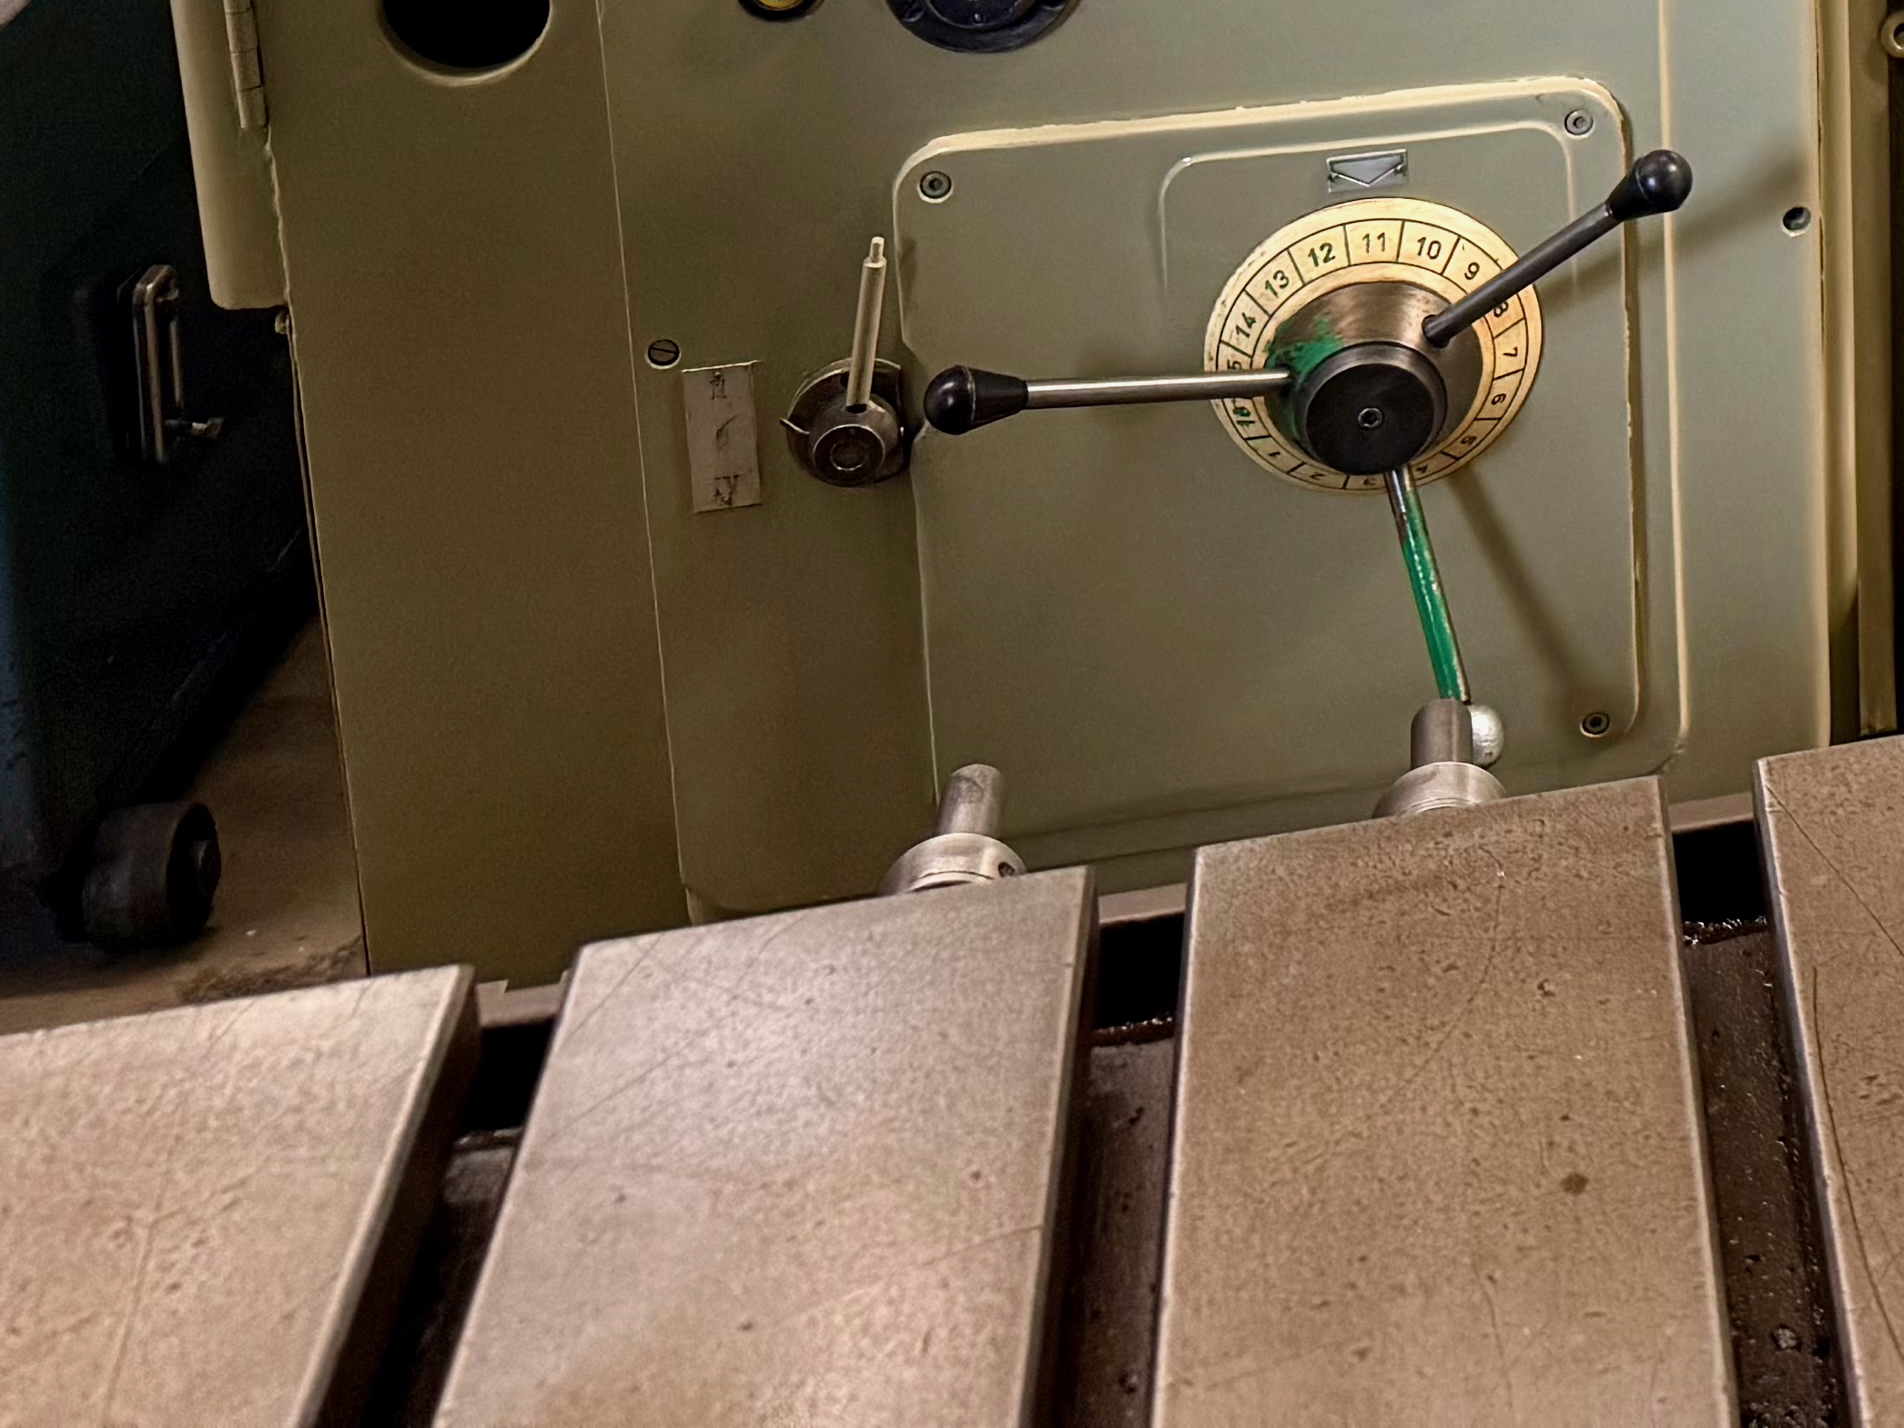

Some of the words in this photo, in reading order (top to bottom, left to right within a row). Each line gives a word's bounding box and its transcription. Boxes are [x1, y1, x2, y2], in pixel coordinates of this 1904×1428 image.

[1361, 231, 1388, 254] 11
[1416, 236, 1443, 261] 10
[1306, 242, 1336, 269] 12
[1463, 261, 1481, 281] 9
[1264, 269, 1291, 299] 13
[1235, 315, 1257, 339] 14
[1502, 346, 1519, 359] 7
[1490, 391, 1507, 407] 6
[1460, 434, 1477, 449] 5
[1268, 449, 1282, 459] 1
[1309, 470, 1326, 481] 2
